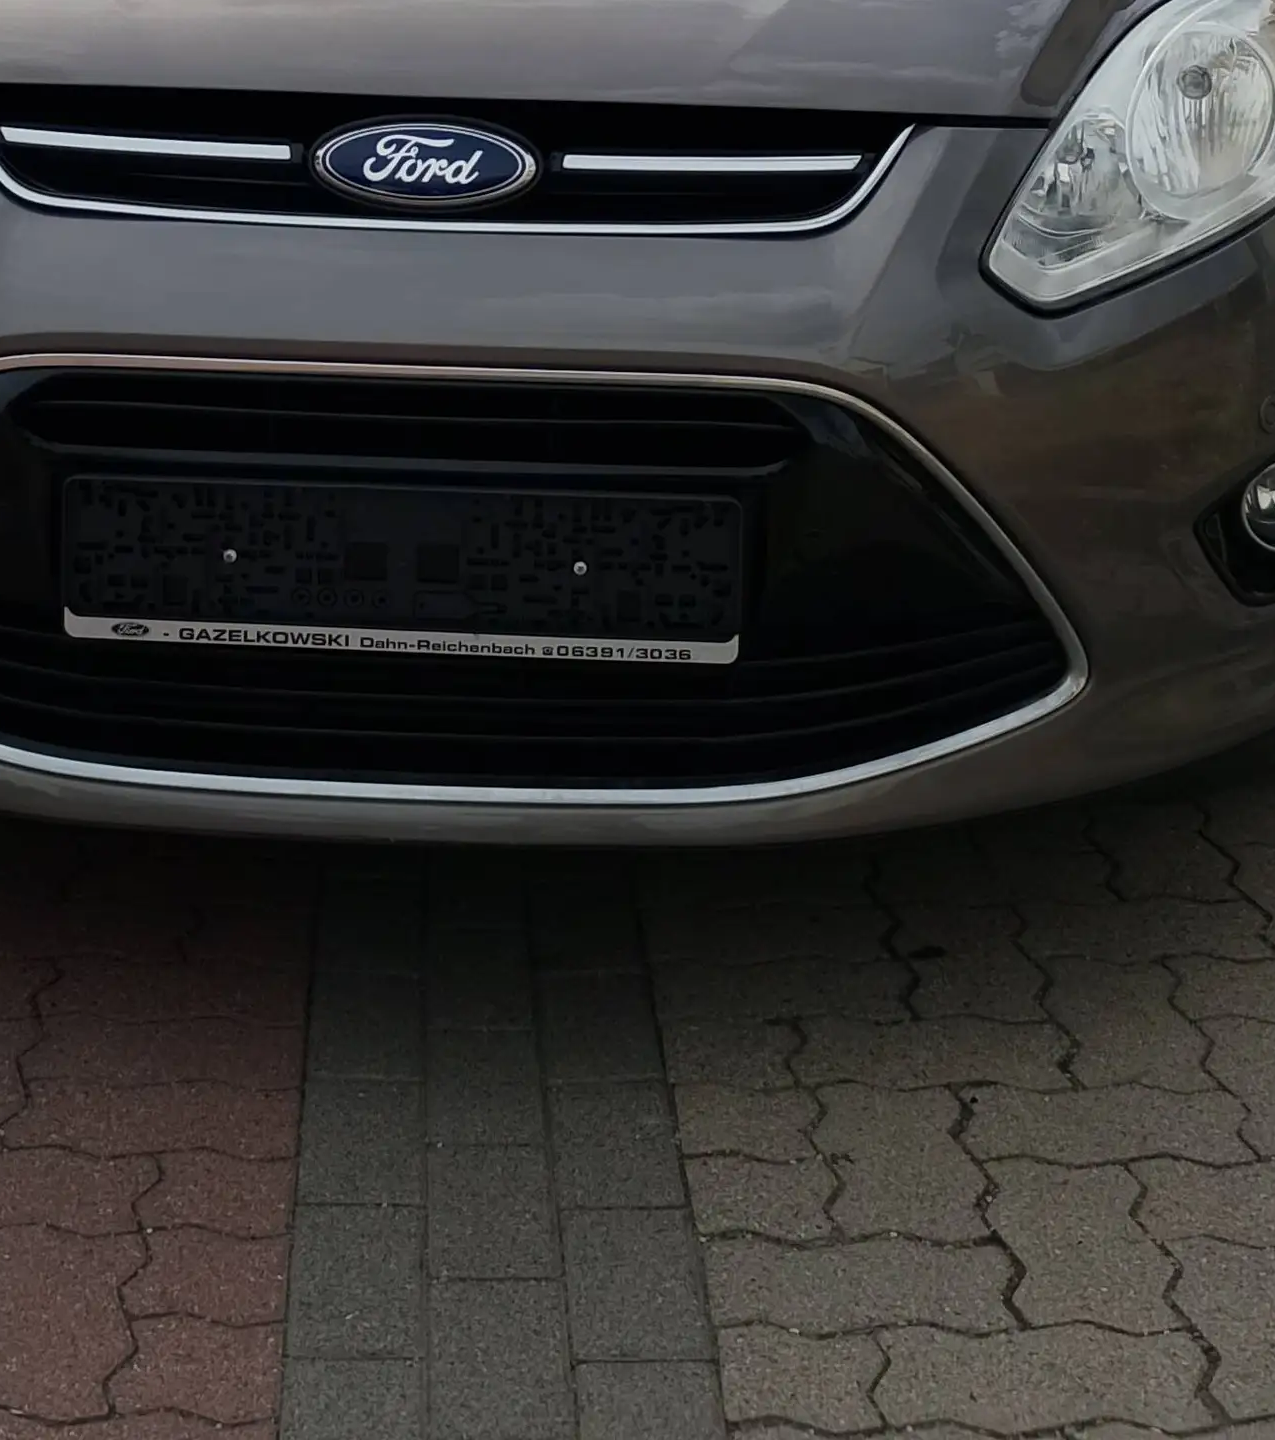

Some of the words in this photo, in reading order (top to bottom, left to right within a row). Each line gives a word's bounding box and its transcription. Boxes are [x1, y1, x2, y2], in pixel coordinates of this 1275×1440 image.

[363, 134, 483, 185] Ford
[178, 627, 350, 647] GAZELKOWSKI
[360, 636, 535, 657] Dahn-Reichenbach
[556, 645, 691, 660] 06391/3036
